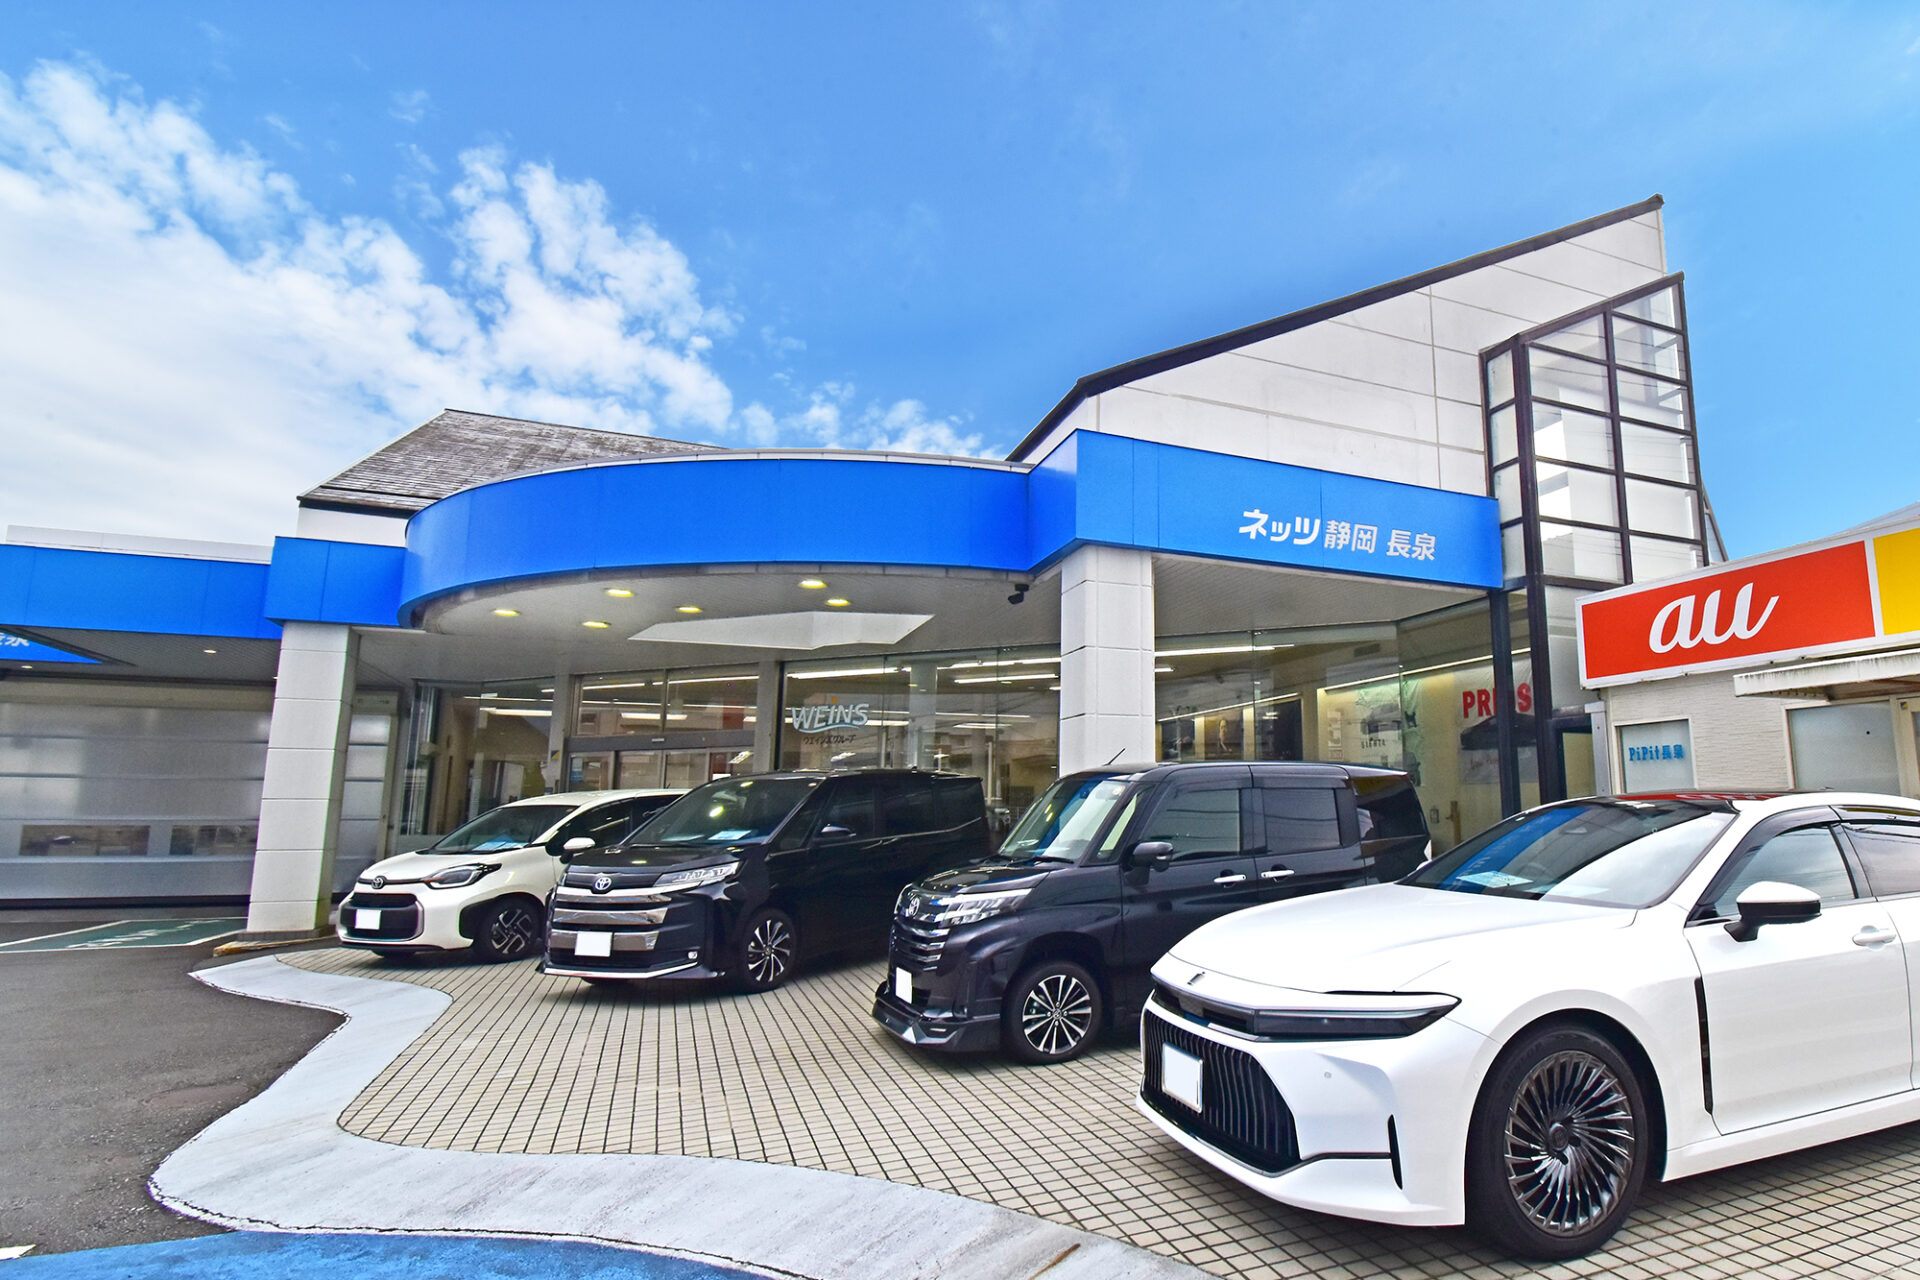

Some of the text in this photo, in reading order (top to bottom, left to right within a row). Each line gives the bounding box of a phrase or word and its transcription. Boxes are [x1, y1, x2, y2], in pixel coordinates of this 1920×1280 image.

[1238, 508, 1436, 561] ネッツ静岡 長泉
[1649, 582, 1780, 654] au
